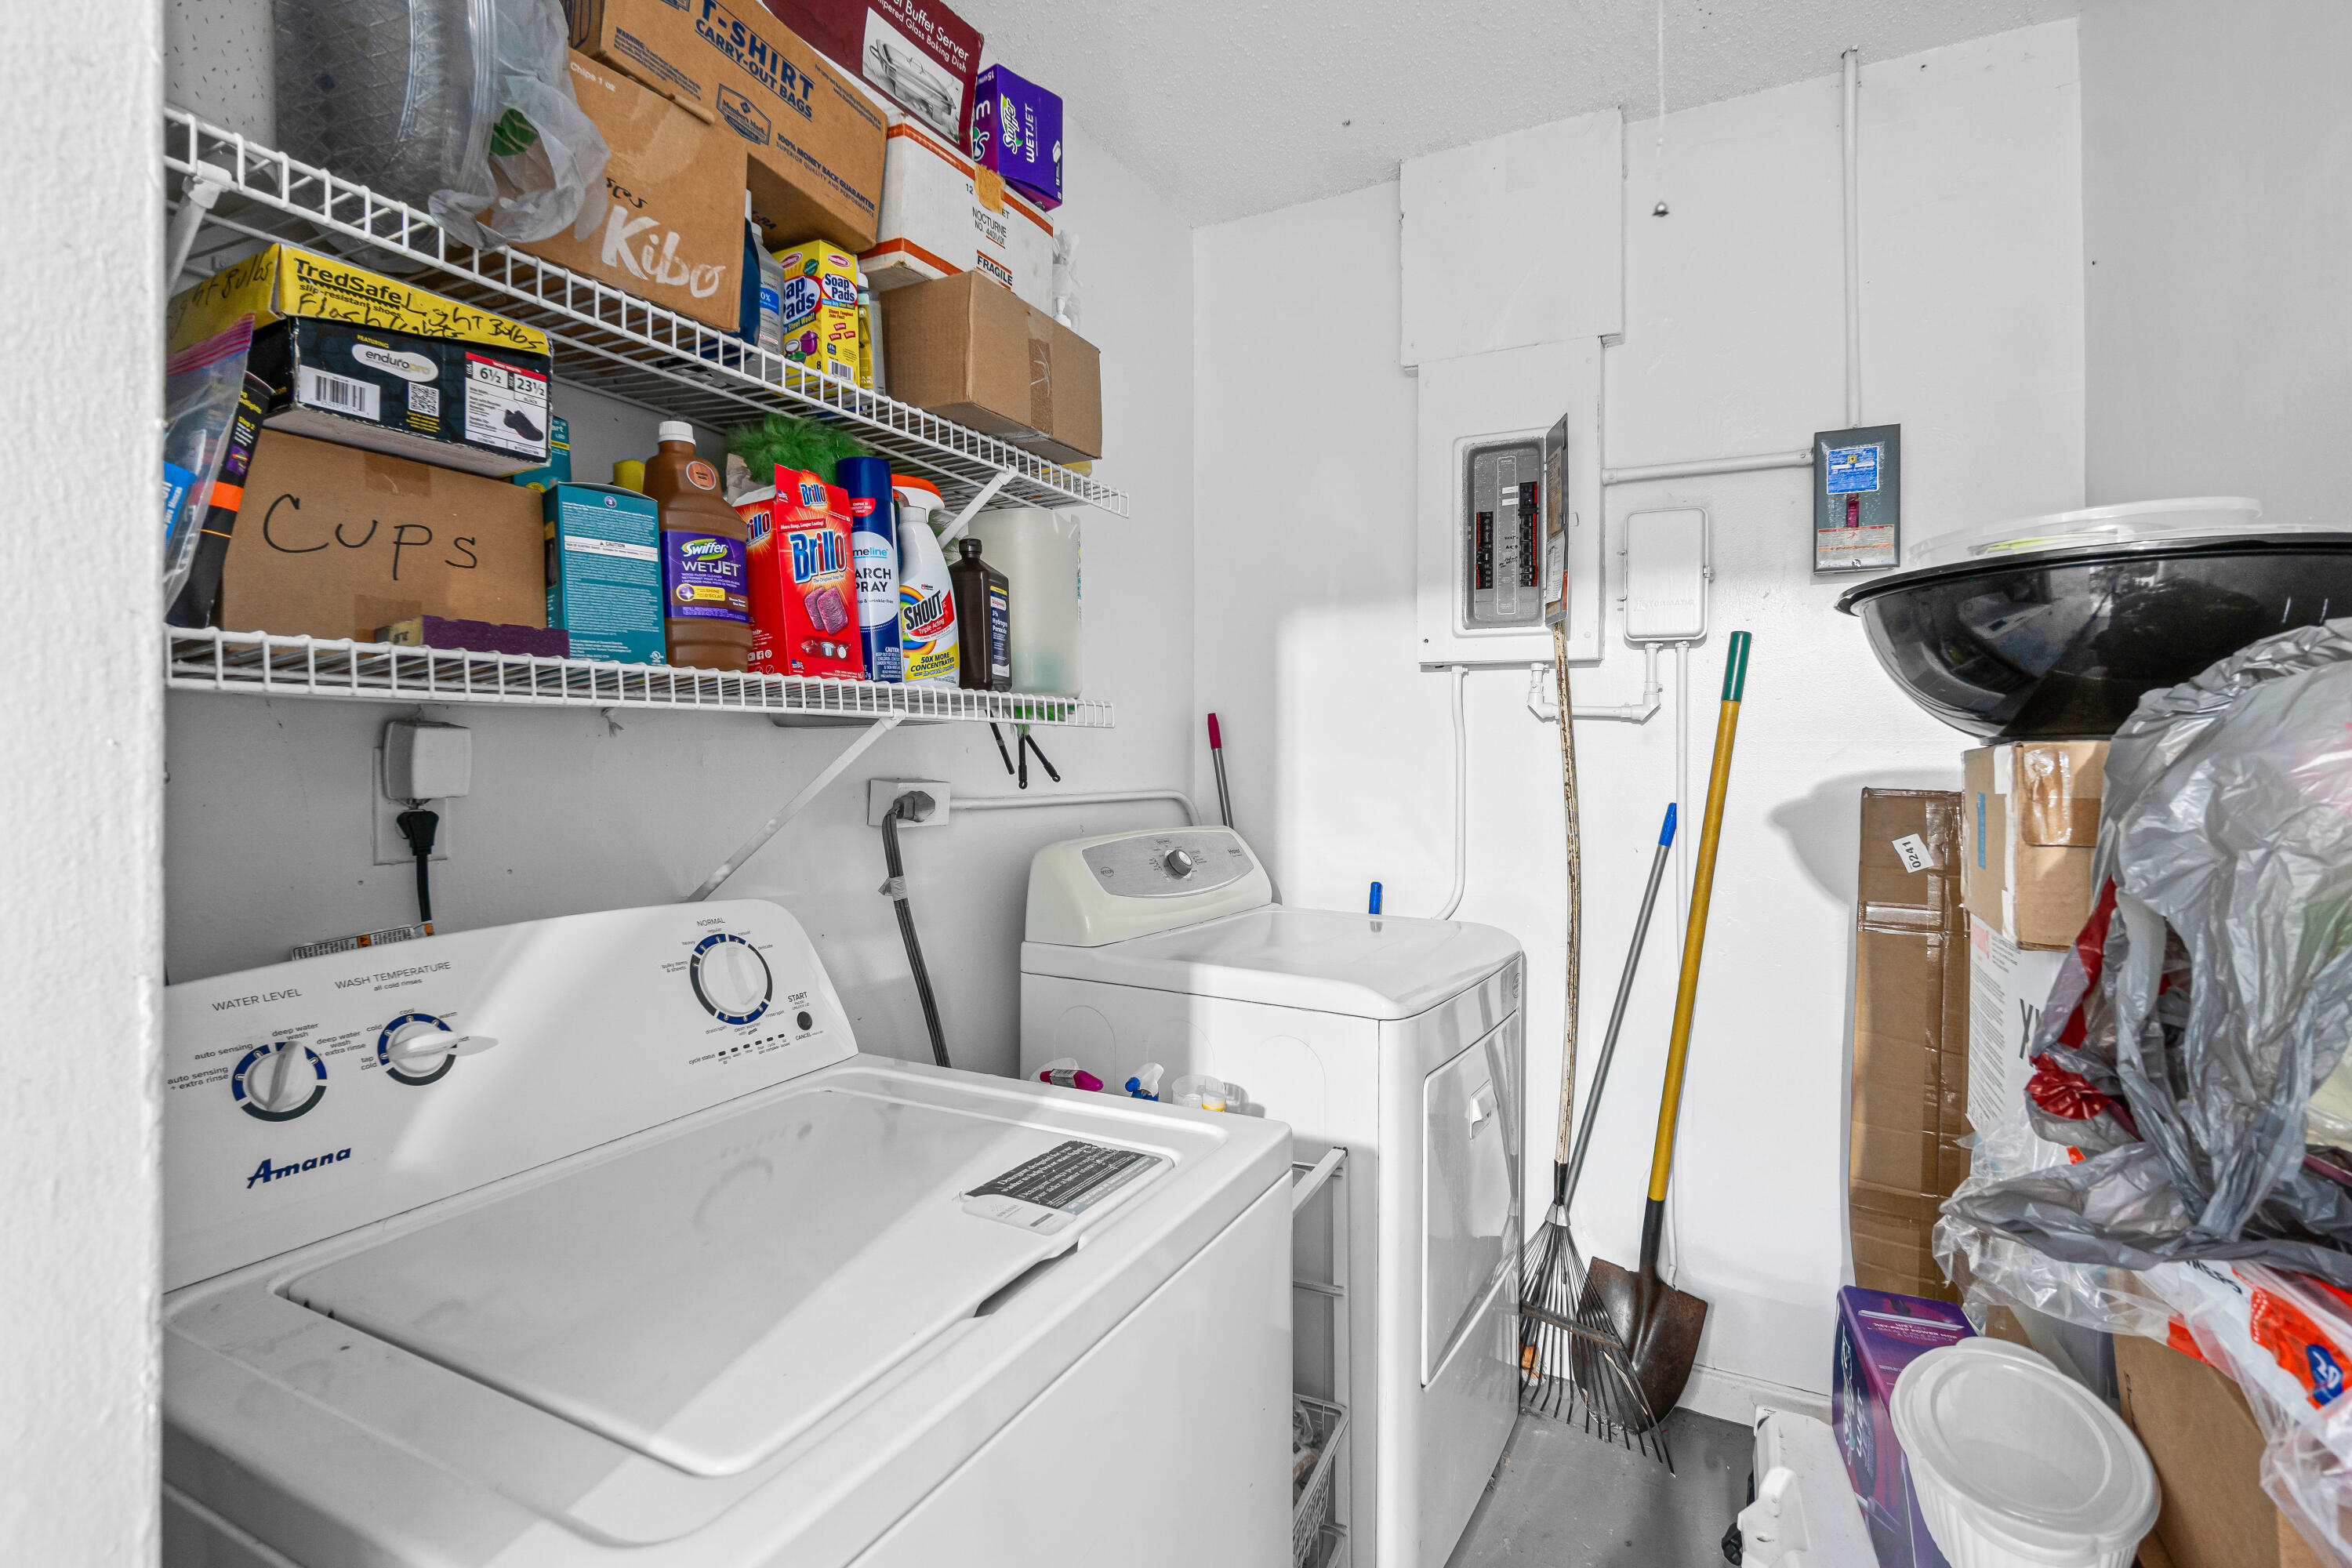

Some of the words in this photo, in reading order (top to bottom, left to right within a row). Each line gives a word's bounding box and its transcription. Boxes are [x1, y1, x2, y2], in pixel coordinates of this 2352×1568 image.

[906, 0, 934, 34] Buffet
[937, 27, 969, 61] Server
[702, 0, 815, 101] T-SHIRT
[906, 19, 924, 40] Glass
[927, 36, 949, 62] Baking
[952, 55, 967, 72] Dish
[695, 19, 777, 89] CARRY-OUT
[779, 85, 812, 118] BAGS
[570, 62, 597, 82] Chips
[604, 82, 616, 92] oz
[1002, 97, 1019, 154] Swiffer
[1025, 103, 1035, 163] WETJET
[778, 132, 796, 152] 100%
[797, 147, 821, 170] MONEY
[822, 166, 839, 184] BACK
[840, 180, 875, 210] GUARANTEE
[776, 141, 802, 165] SUPERIOR
[804, 162, 827, 182] QUALITY
[828, 180, 839, 192] AND
[840, 189, 874, 218] PERFORMANCE
[966, 183, 974, 194] 12
[972, 207, 1007, 238] NOCTURNE
[601, 204, 726, 299] Kibo
[977, 255, 1013, 286] FRAGILE
[294, 257, 401, 303] TredSafe
[825, 273, 850, 291] Soap
[299, 284, 370, 307] slip-resistant
[831, 286, 855, 302] Pads
[357, 334, 390, 349] FEATURING
[800, 483, 827, 506] Brillo
[683, 542, 726, 557] Swiffer
[789, 529, 847, 583] Brillo
[681, 561, 739, 577] WETJET
[903, 590, 942, 630] SHOUT
[918, 625, 932, 634] Triple
[931, 618, 945, 628] Acting
[992, 617, 1008, 628] Hydrogen
[993, 626, 1007, 635] Peroxide
[910, 656, 955, 672] CONCENTRATED
[920, 655, 935, 663] 50X
[935, 652, 949, 661] MORE
[1901, 840, 1922, 869] 0241
[697, 916, 726, 927] NORMAL
[661, 961, 676, 970] bulky
[335, 975, 371, 989] WASH
[372, 961, 452, 982] TEMPERATURE
[212, 995, 260, 1011] WATER
[263, 989, 303, 1003] LEVEL
[787, 991, 808, 1003] START
[271, 1028, 294, 1038] deep
[295, 1022, 319, 1032] water
[286, 1032, 309, 1040] wash
[366, 1024, 383, 1033] cold
[795, 1032, 811, 1040] CANCEL
[316, 1035, 338, 1045] deep
[338, 1030, 361, 1040] water
[329, 1039, 351, 1048] wash
[194, 1050, 216, 1060] auto
[218, 1044, 253, 1056] sensing
[325, 1047, 346, 1057] extra
[347, 1043, 367, 1051] rinse
[361, 1055, 374, 1065] tap
[361, 1062, 378, 1071] cold
[688, 1055, 702, 1065] cycle
[167, 1074, 190, 1085] auto
[191, 1066, 229, 1080] sensing
[179, 1079, 204, 1090] extra
[205, 1073, 229, 1084] rinse
[246, 1147, 352, 1189] Amana
